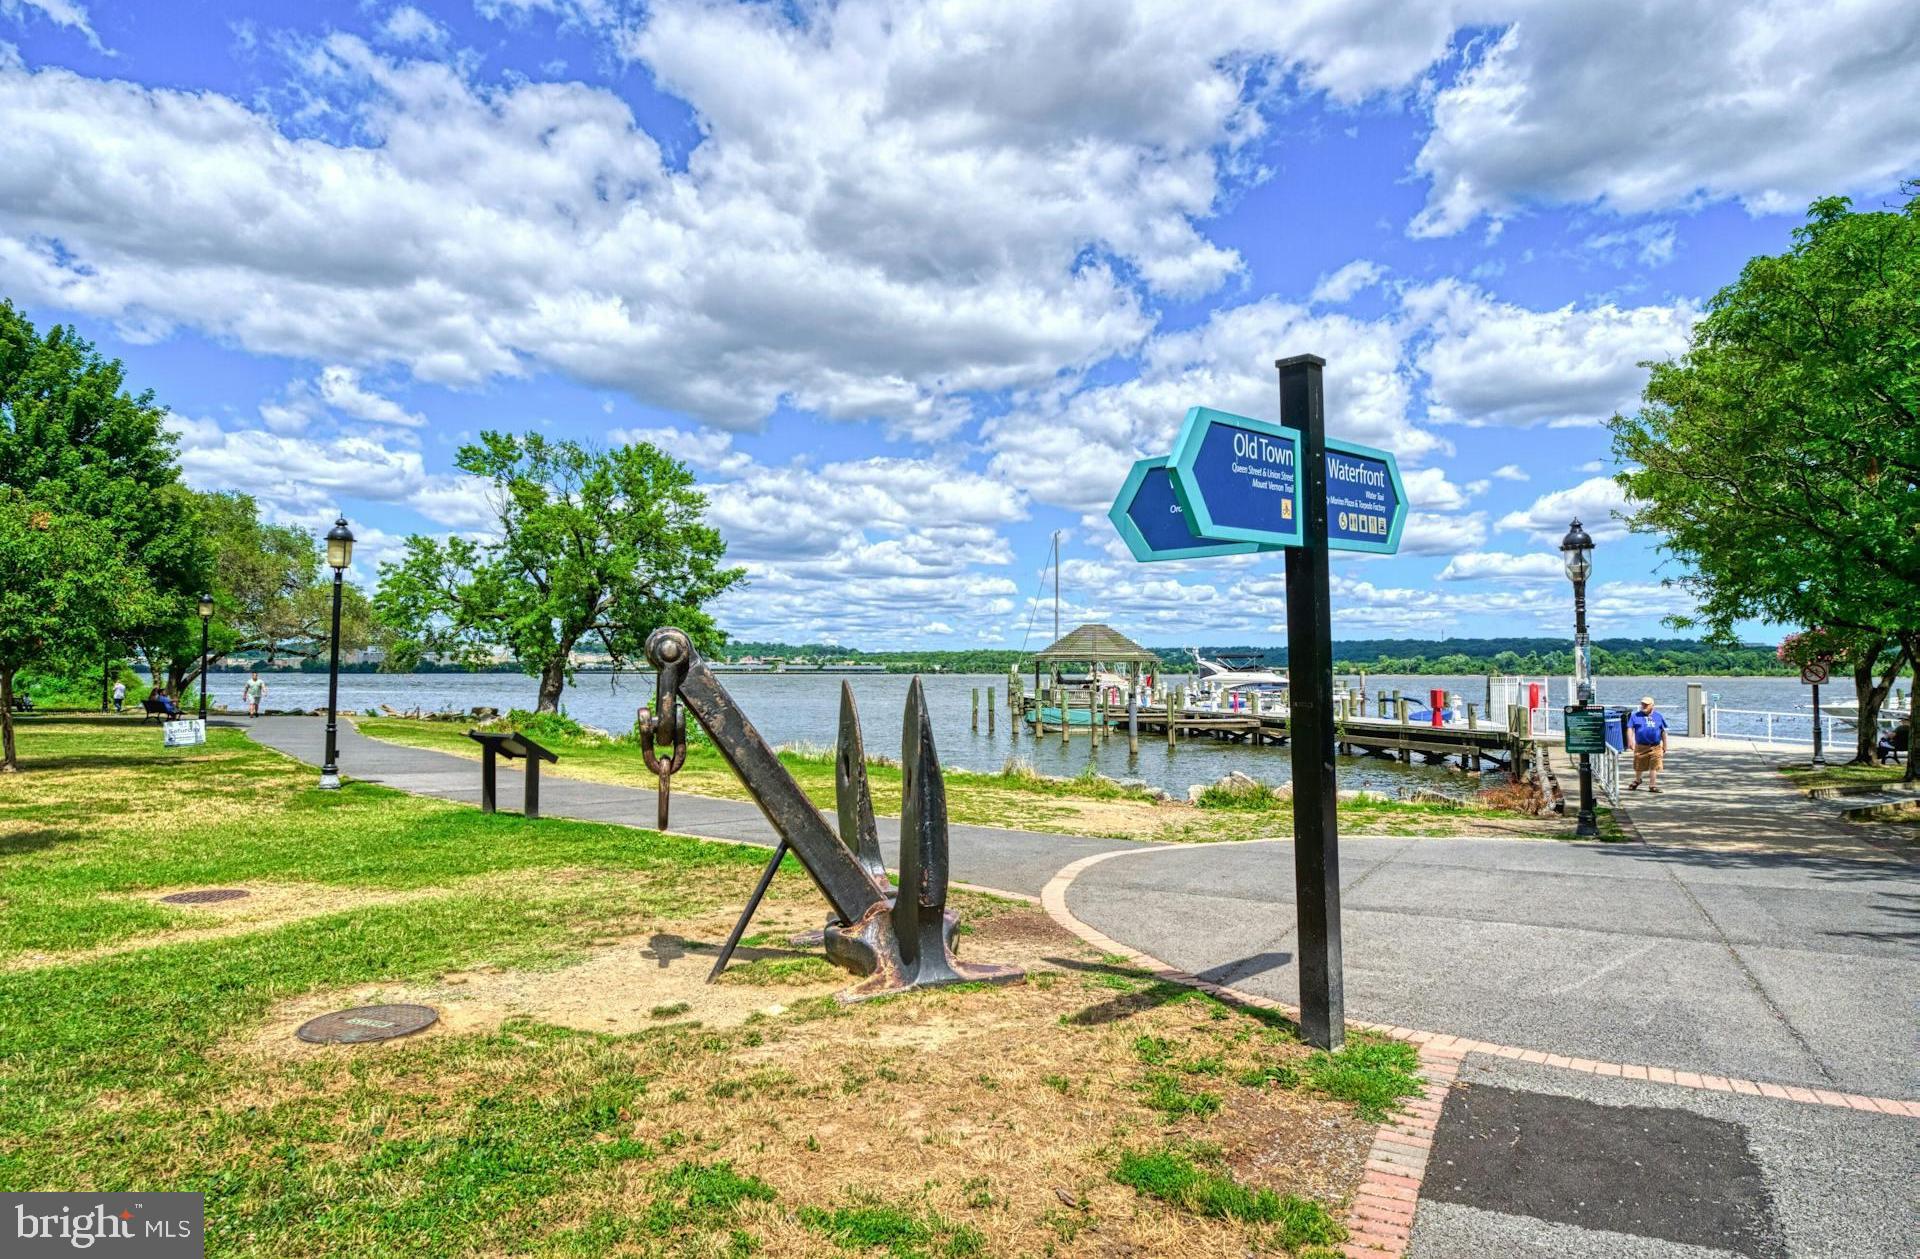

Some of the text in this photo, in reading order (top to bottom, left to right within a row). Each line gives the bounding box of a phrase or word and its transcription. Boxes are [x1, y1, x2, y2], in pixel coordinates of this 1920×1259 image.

[1233, 433, 1294, 467] Old Town
[1232, 462, 1294, 482] Queen Street & Union Street
[1327, 457, 1385, 488] Waterfront
[1252, 478, 1294, 494] Mount Vernon Trail
[1359, 500, 1373, 510] Torpedo
[1373, 502, 1386, 514] Factory
